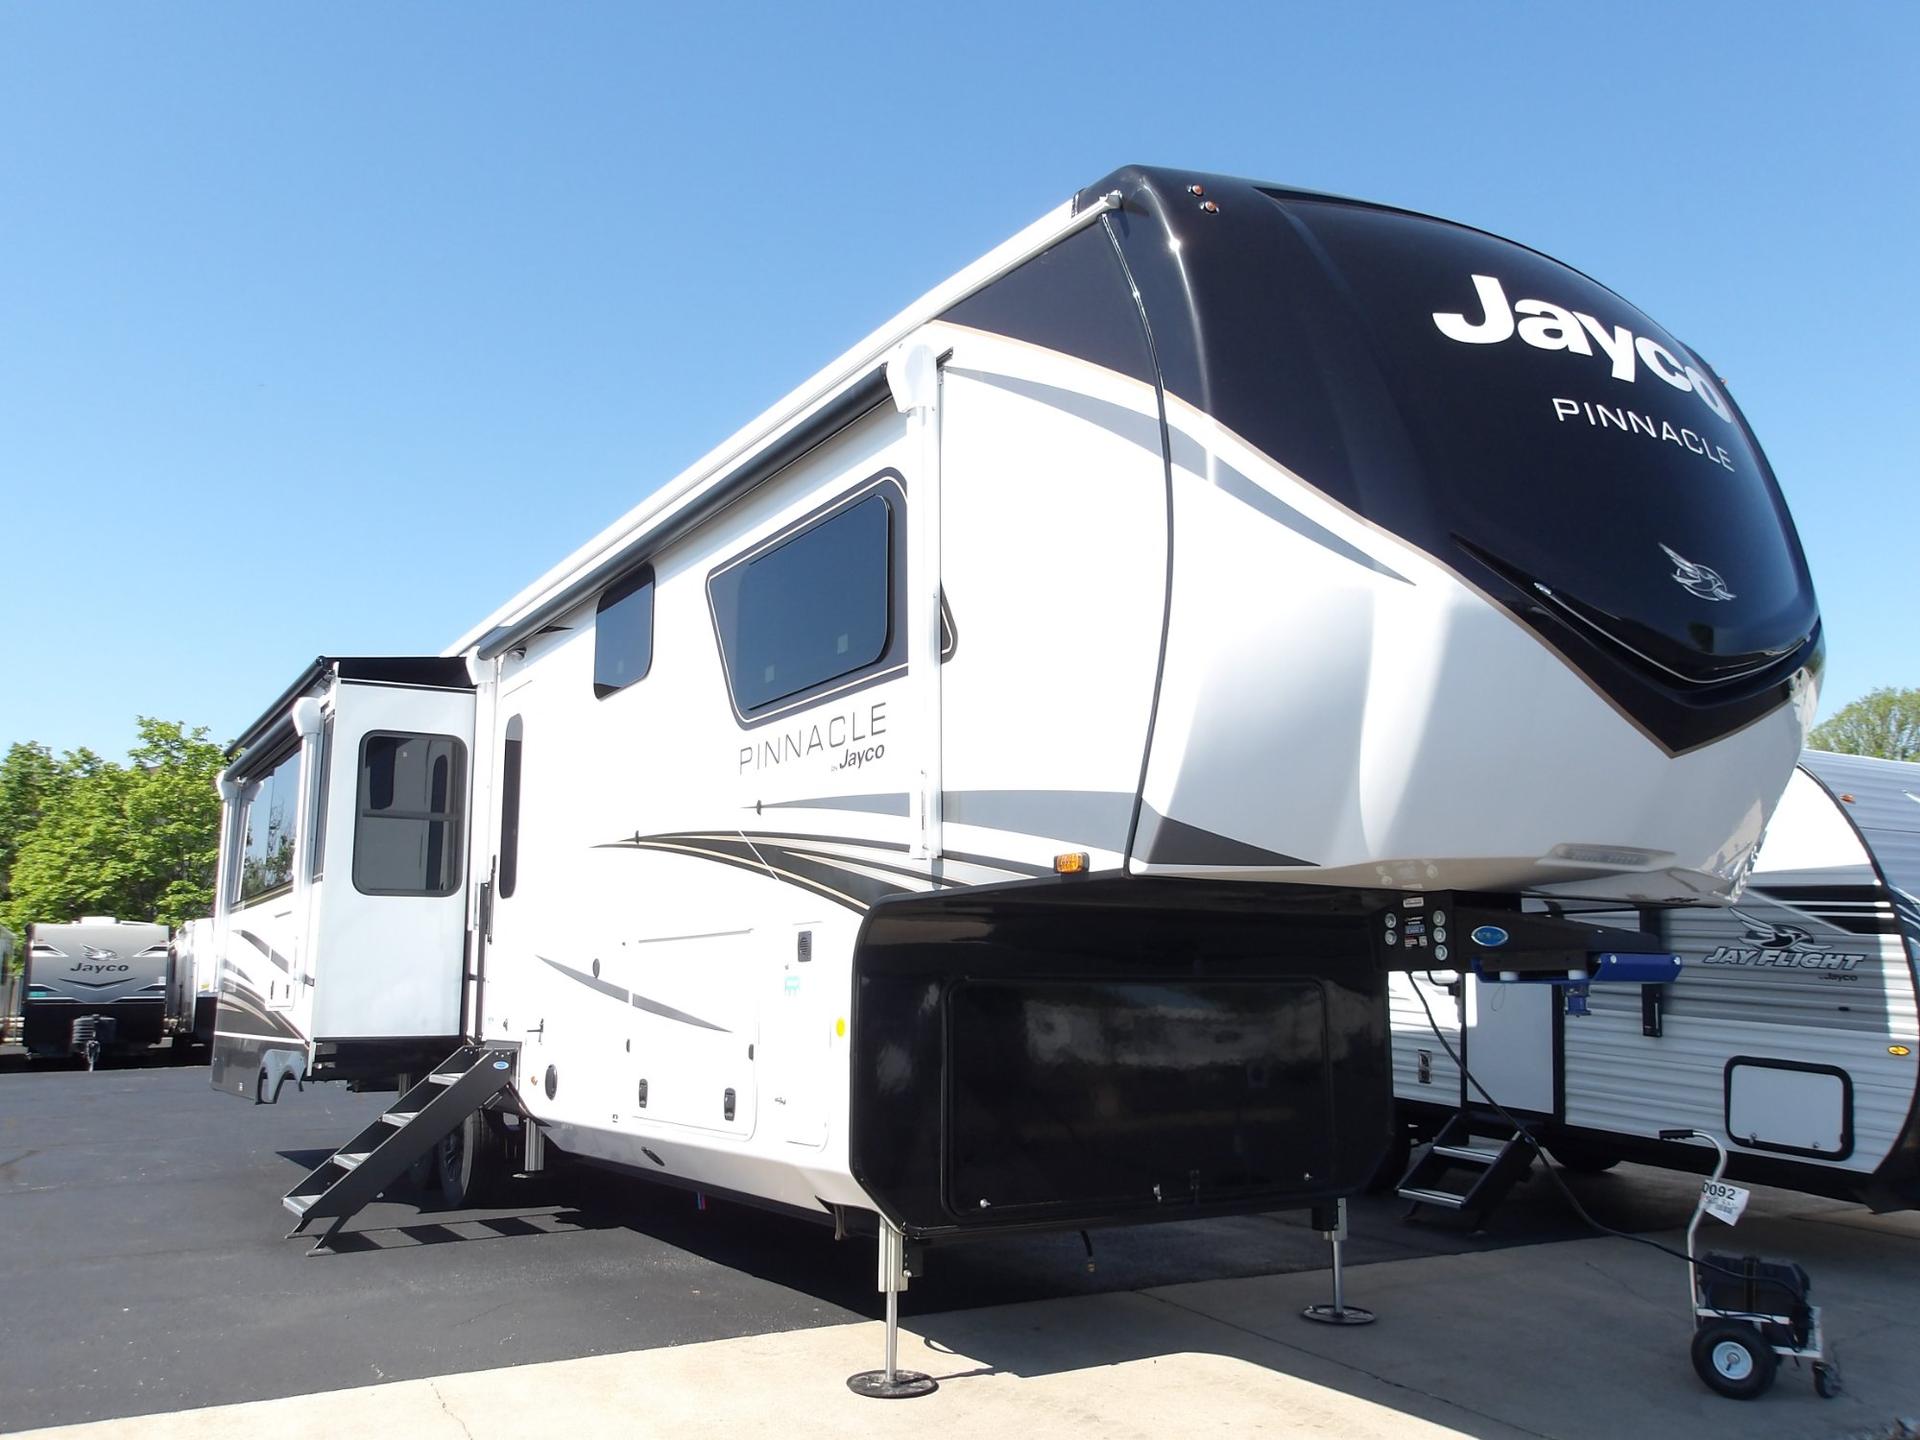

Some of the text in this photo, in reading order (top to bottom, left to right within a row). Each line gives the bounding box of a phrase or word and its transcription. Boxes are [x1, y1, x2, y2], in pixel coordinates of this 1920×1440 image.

[1432, 274, 1732, 423] Jayco
[1552, 397, 1736, 473] PINNACLE
[739, 702, 887, 775] PINNACLE
[839, 744, 885, 769] Jayco
[70, 962, 129, 974] Jayco
[1704, 947, 1866, 971] JAY FLIGHT
